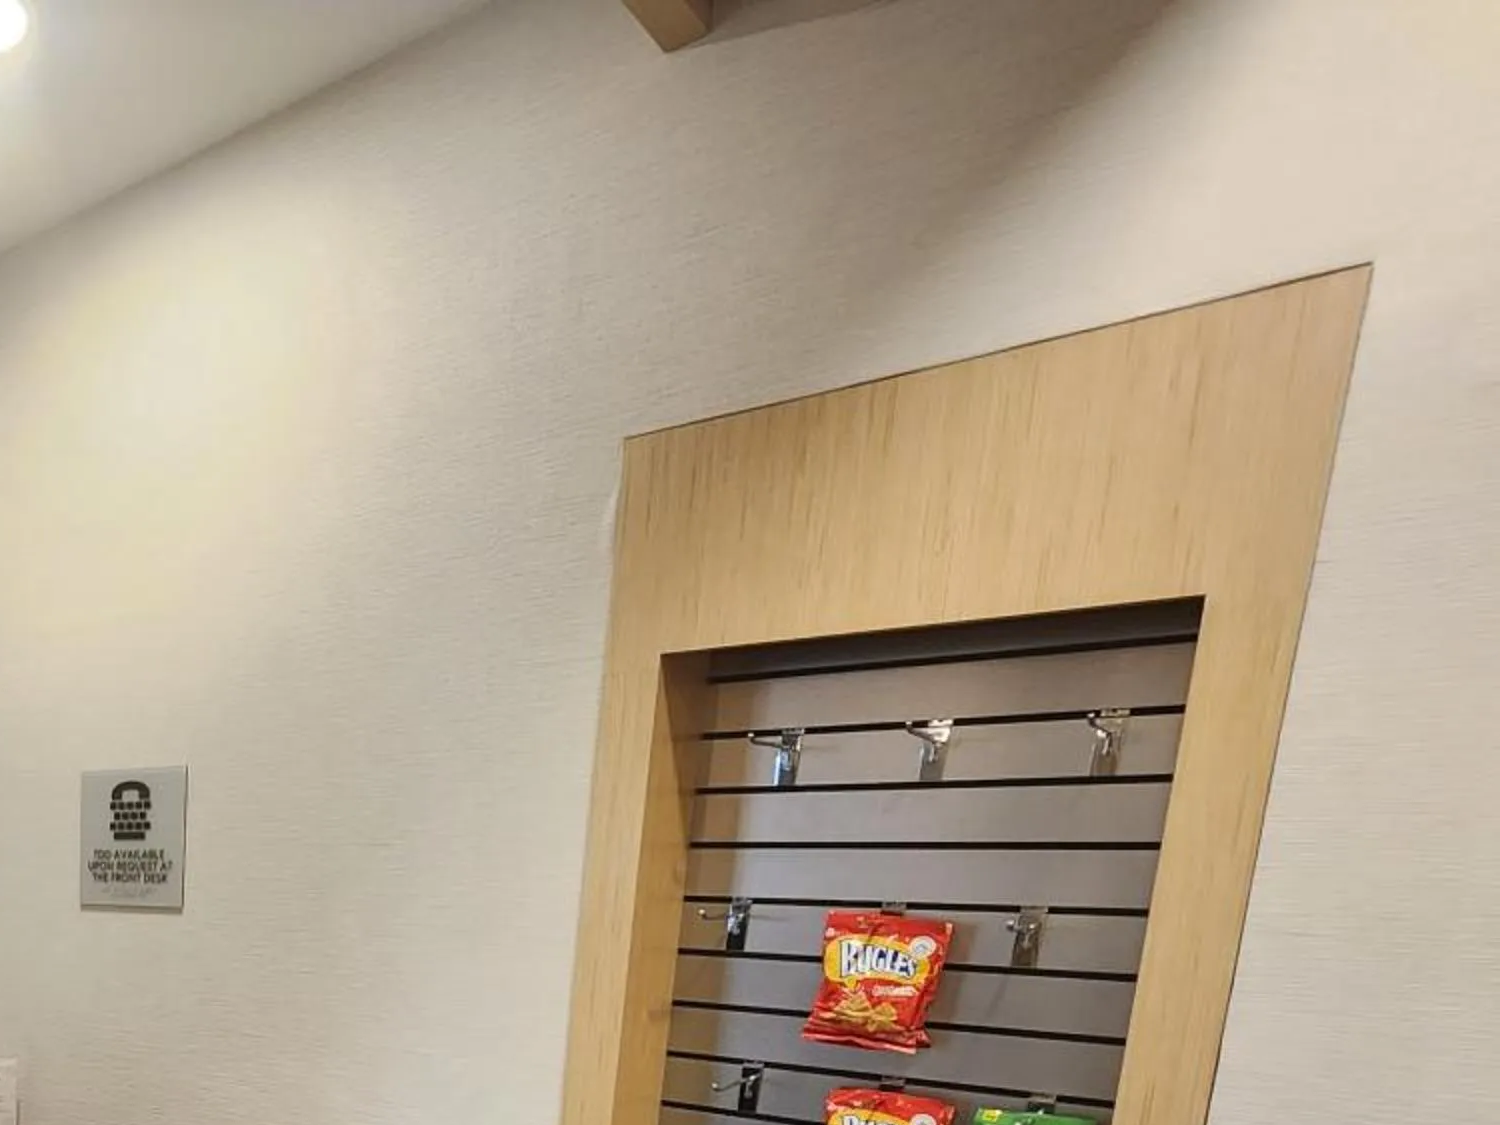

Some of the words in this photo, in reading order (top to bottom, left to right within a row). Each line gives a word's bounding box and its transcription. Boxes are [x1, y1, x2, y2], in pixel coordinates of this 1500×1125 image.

[114, 848, 164, 860] AVAILABLE
[87, 860, 114, 872] UPON
[117, 861, 158, 873] REQUEST
[160, 860, 173, 871] AT
[92, 872, 108, 883] THE
[111, 872, 141, 883] FRONT
[143, 873, 169, 884] DESK
[839, 939, 918, 979] BUGLES
